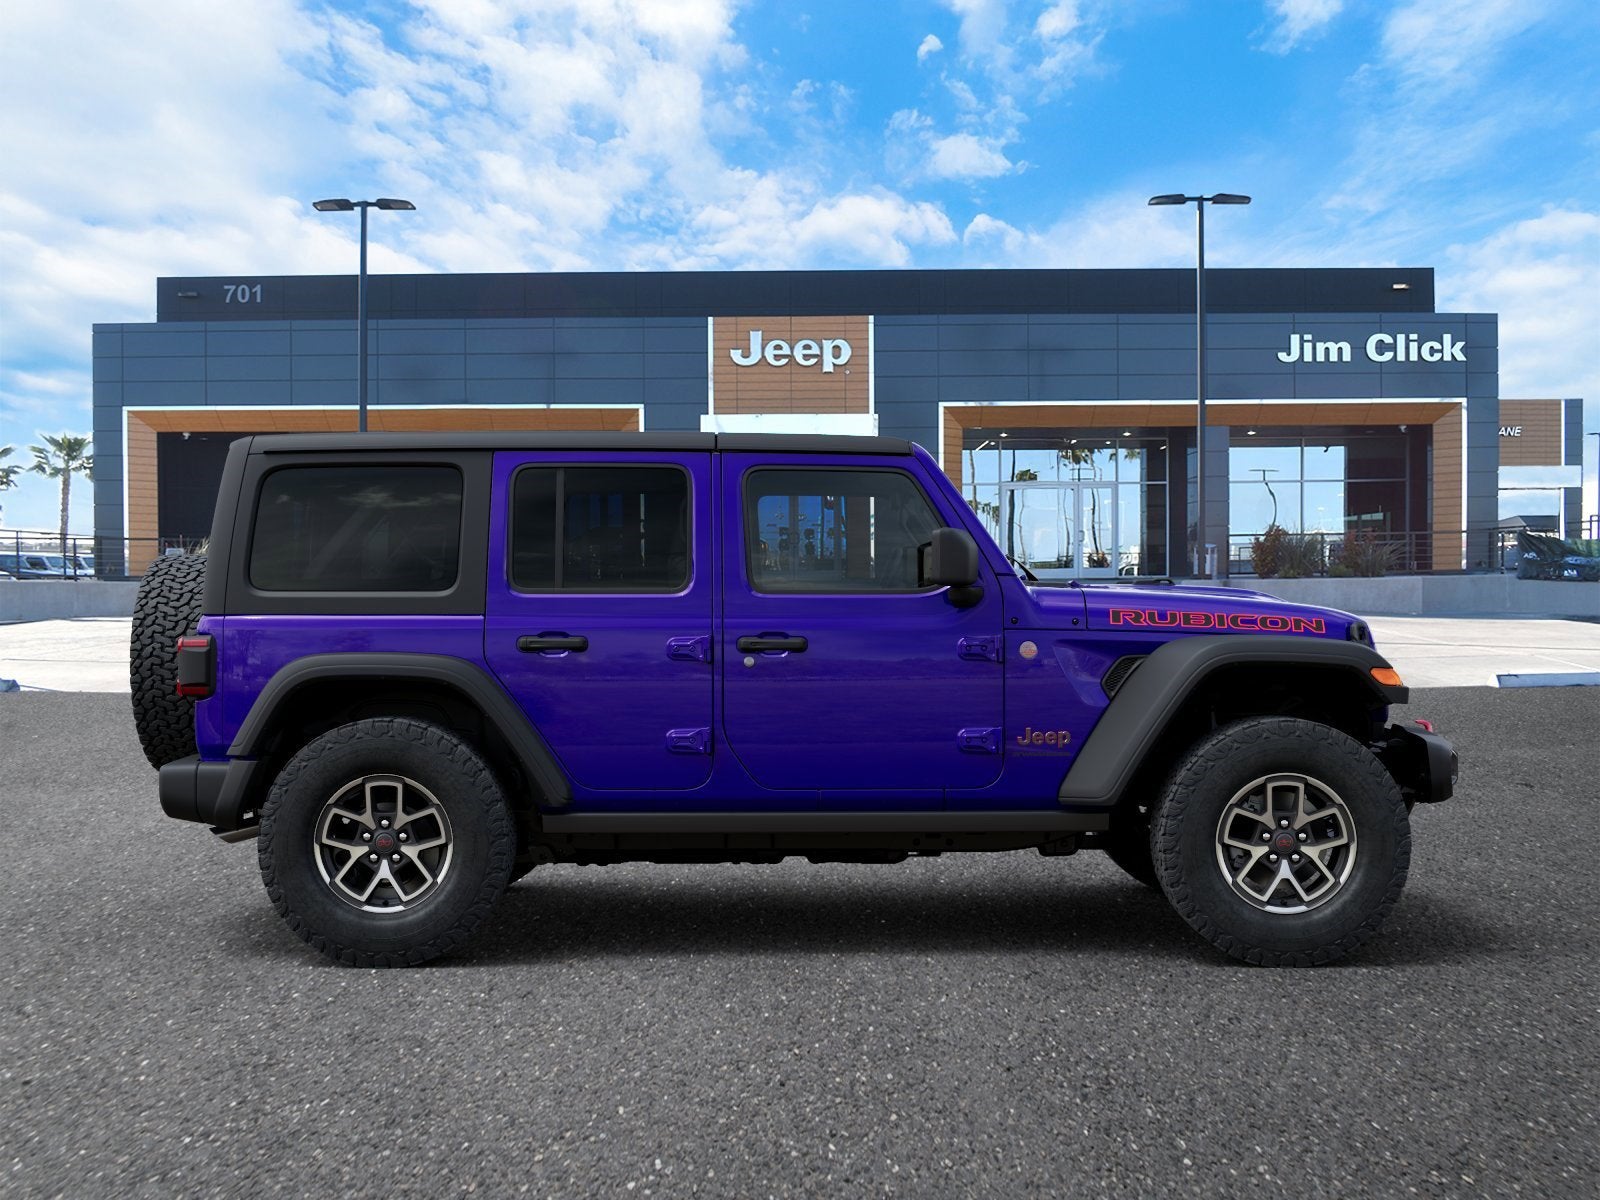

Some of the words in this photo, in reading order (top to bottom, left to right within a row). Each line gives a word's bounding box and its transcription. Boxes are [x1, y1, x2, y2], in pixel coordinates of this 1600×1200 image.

[223, 284, 262, 304] 701
[729, 330, 852, 374] Jeep
[1277, 333, 1352, 363] Jim
[1365, 333, 1467, 363] Click
[1109, 608, 1326, 634] RUBICON
[1016, 727, 1071, 749] Jeep
